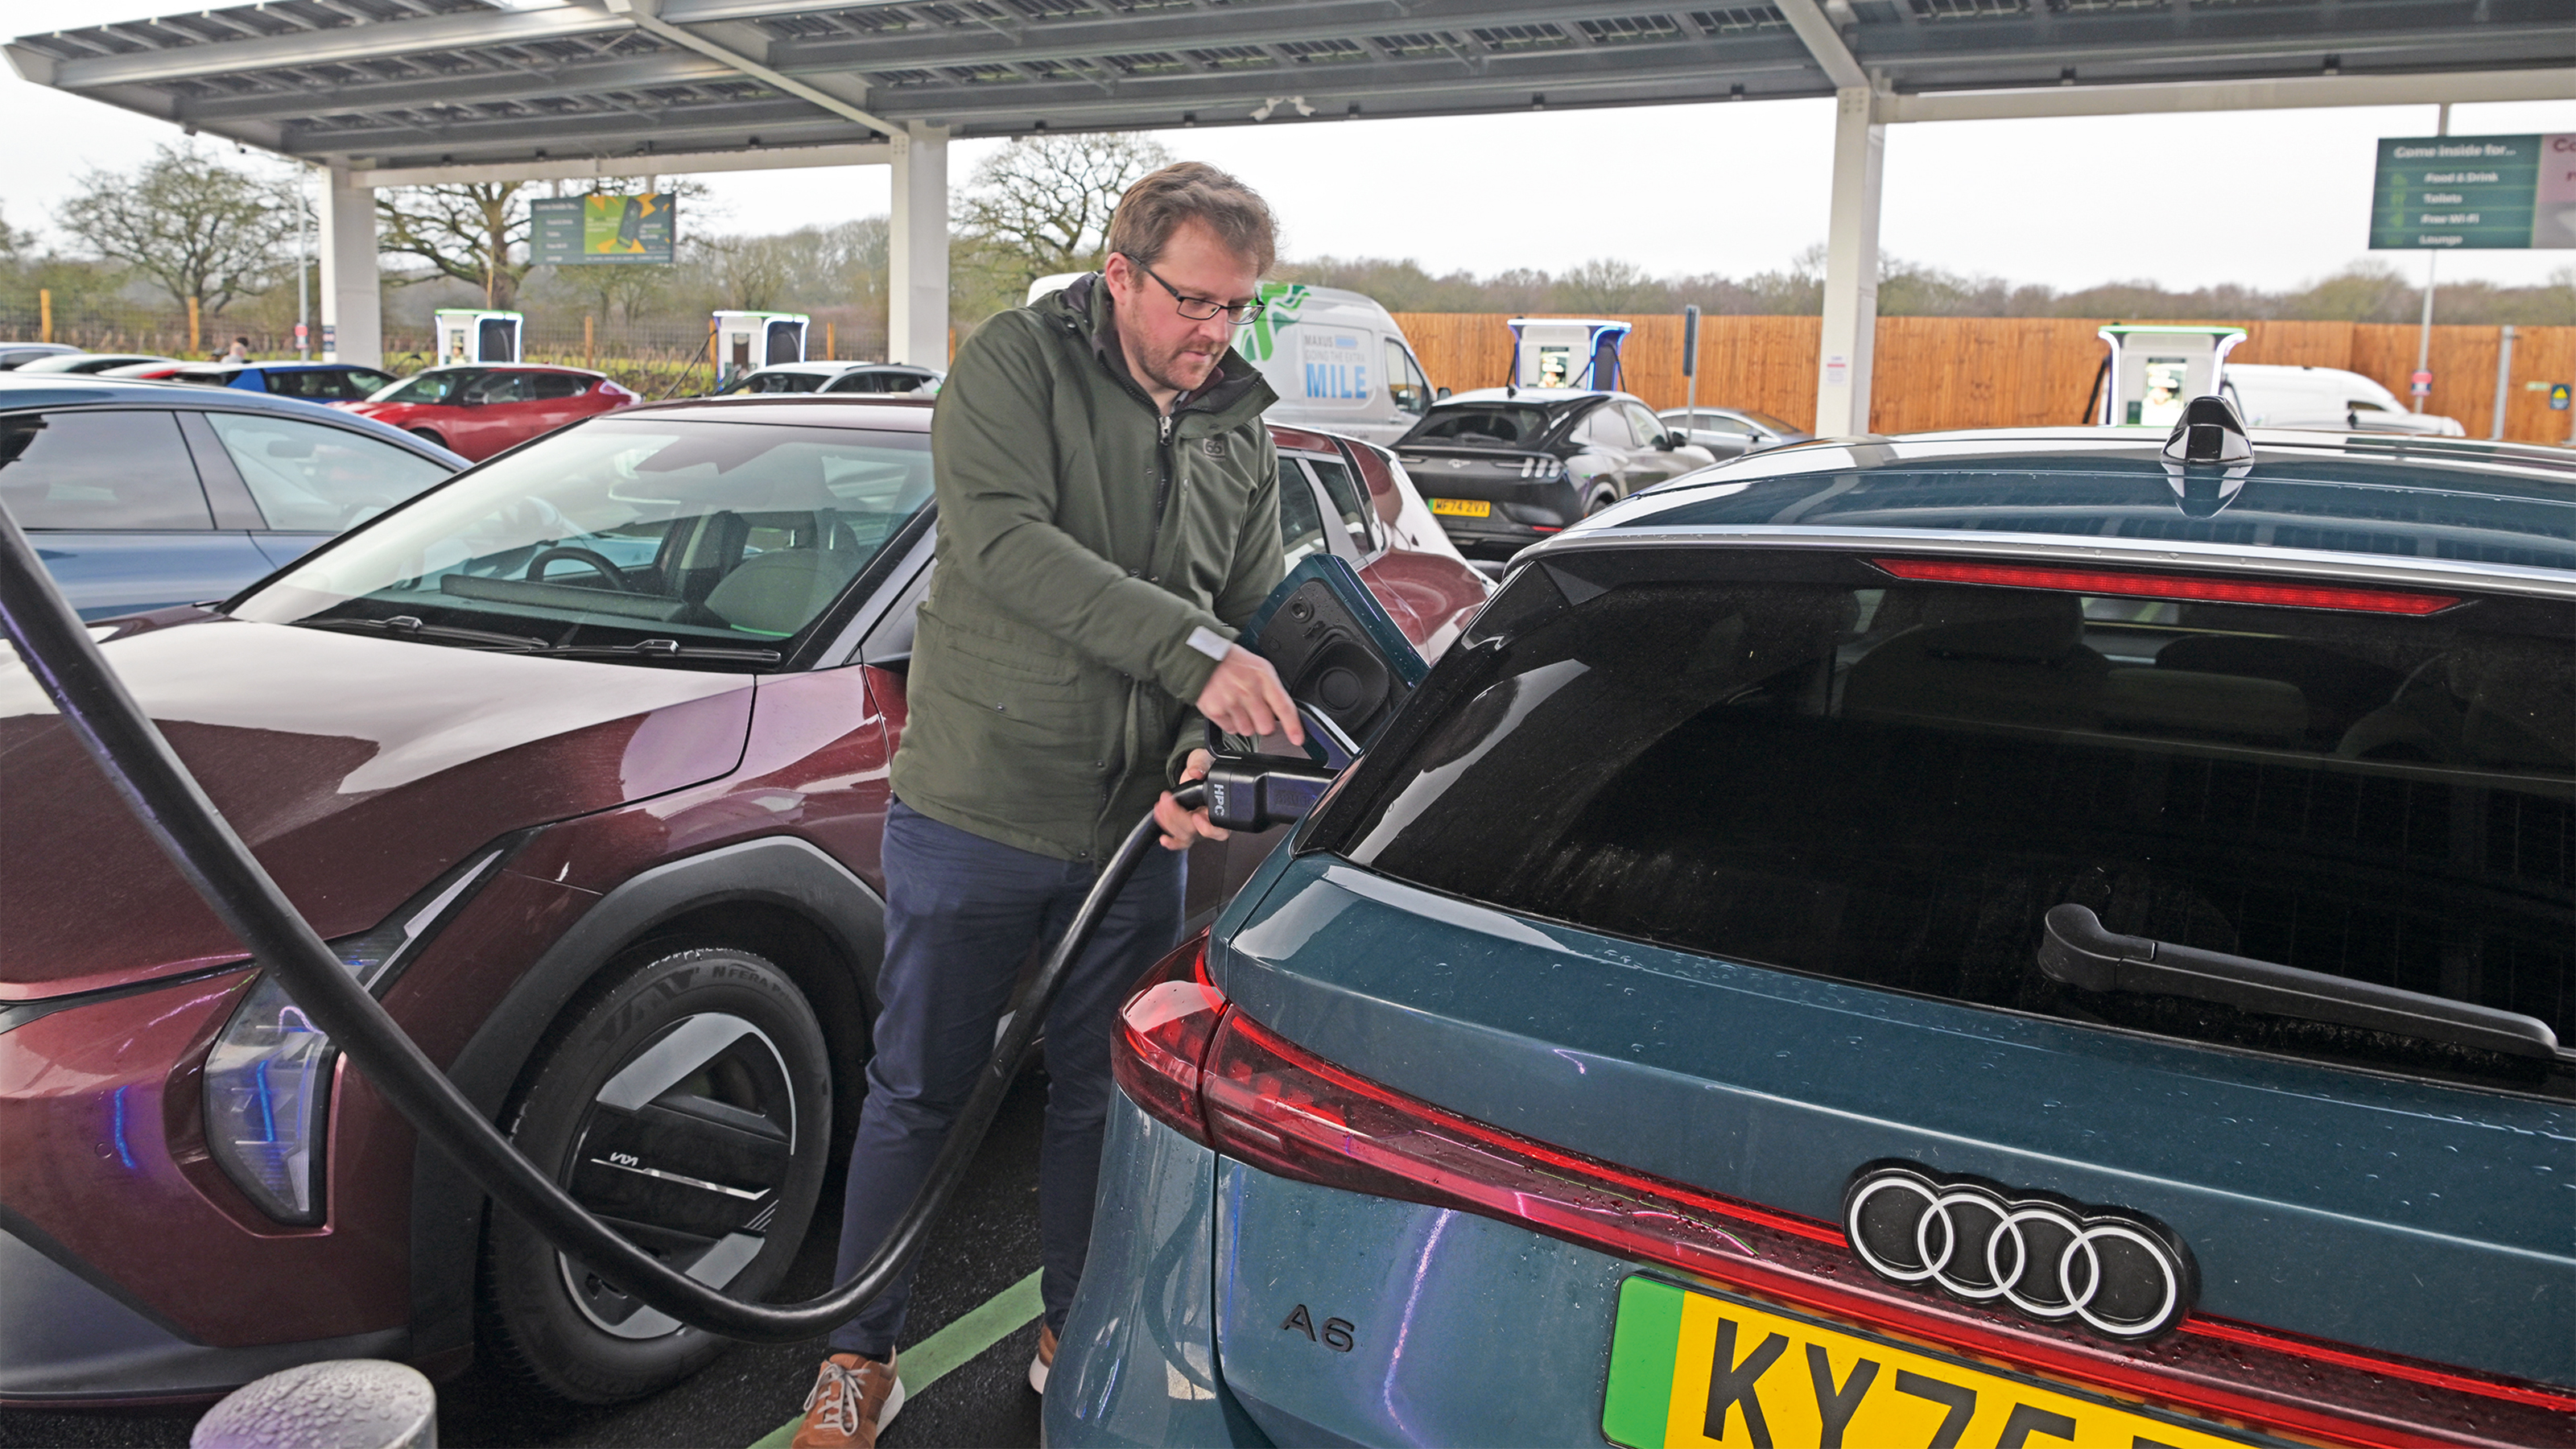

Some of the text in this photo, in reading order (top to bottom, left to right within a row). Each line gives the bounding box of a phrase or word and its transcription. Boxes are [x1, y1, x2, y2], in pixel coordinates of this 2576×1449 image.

[2393, 146, 2436, 159] Come
[2438, 144, 2482, 157] inside
[2424, 172, 2455, 184] Food
[2466, 171, 2499, 183] Drink
[2424, 193, 2462, 204] Toilets
[2420, 213, 2447, 224] Free
[2418, 234, 2462, 246] Lounge
[1304, 335, 1333, 348] MAXUS
[1306, 363, 1367, 398] MILE
[1465, 502, 1488, 514] ZVX
[1213, 783, 1225, 816] HPC
[1278, 1303, 1355, 1352] A6
